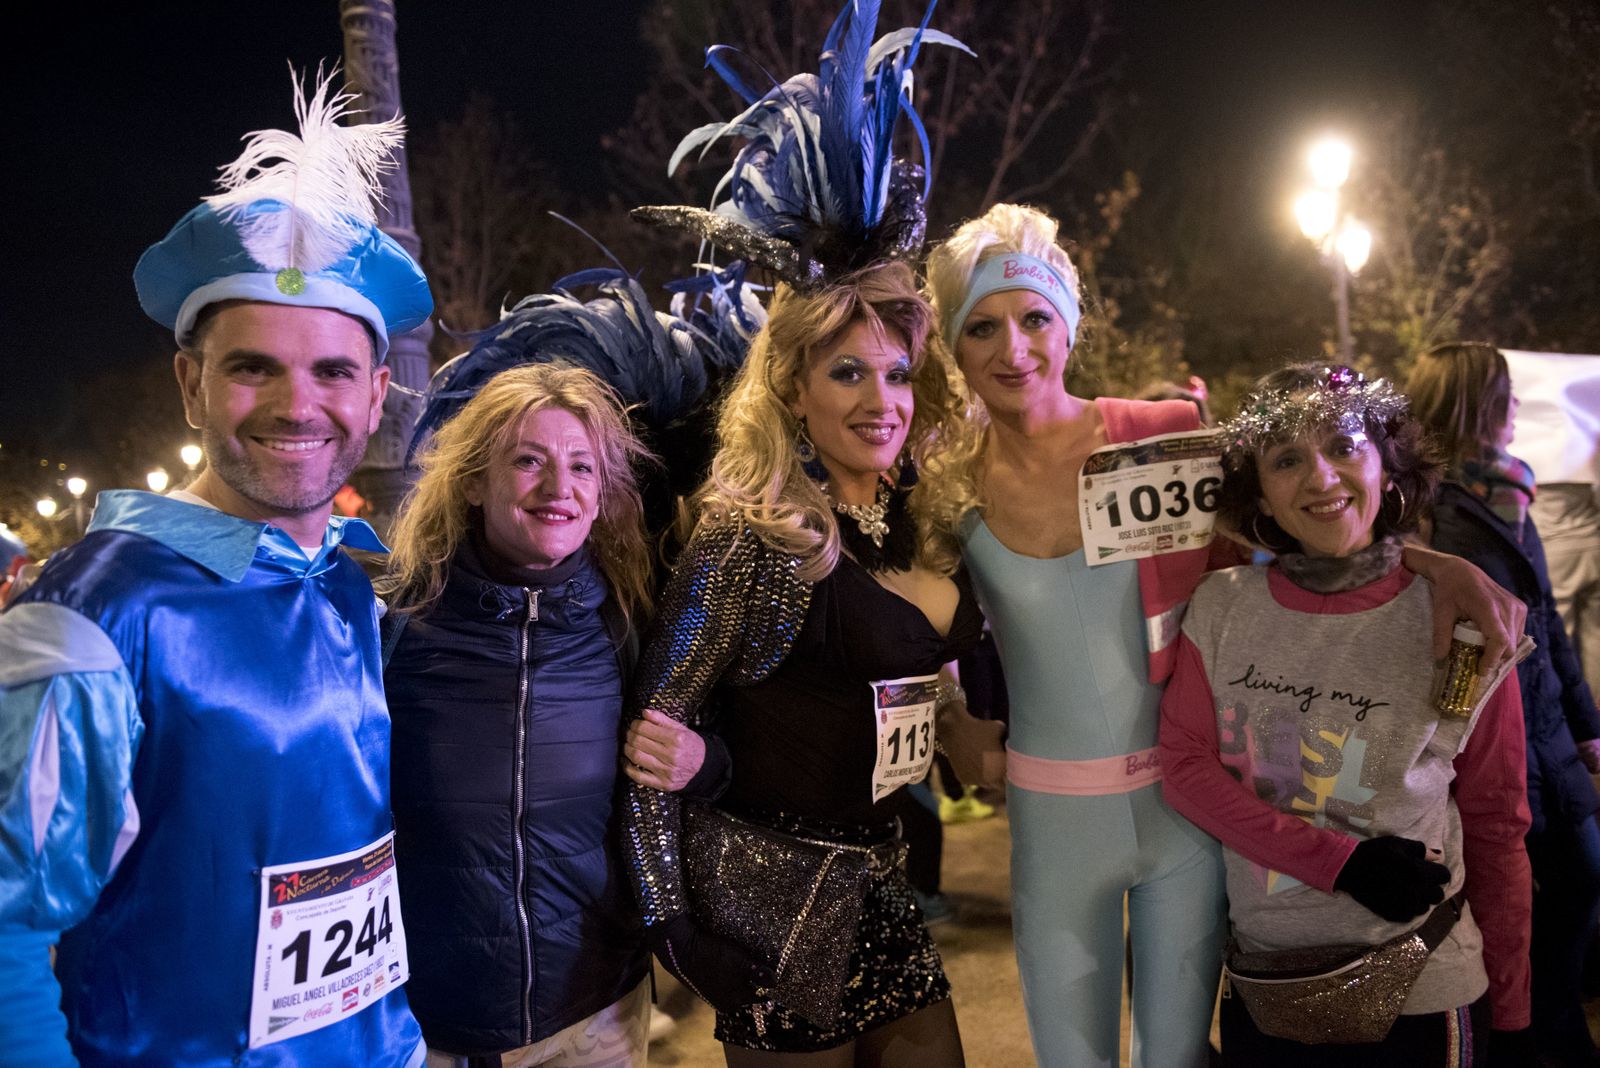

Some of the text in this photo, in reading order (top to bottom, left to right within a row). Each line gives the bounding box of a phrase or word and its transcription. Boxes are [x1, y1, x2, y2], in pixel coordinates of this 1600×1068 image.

[1004, 260, 1045, 281] Barbie
[1096, 476, 1220, 528] 1036
[1229, 664, 1390, 721] living my
[1216, 701, 1405, 788] BEST
[281, 895, 393, 985] 1244
[272, 995, 302, 1011] MIGUEL
[303, 986, 327, 1002] ANGEL
